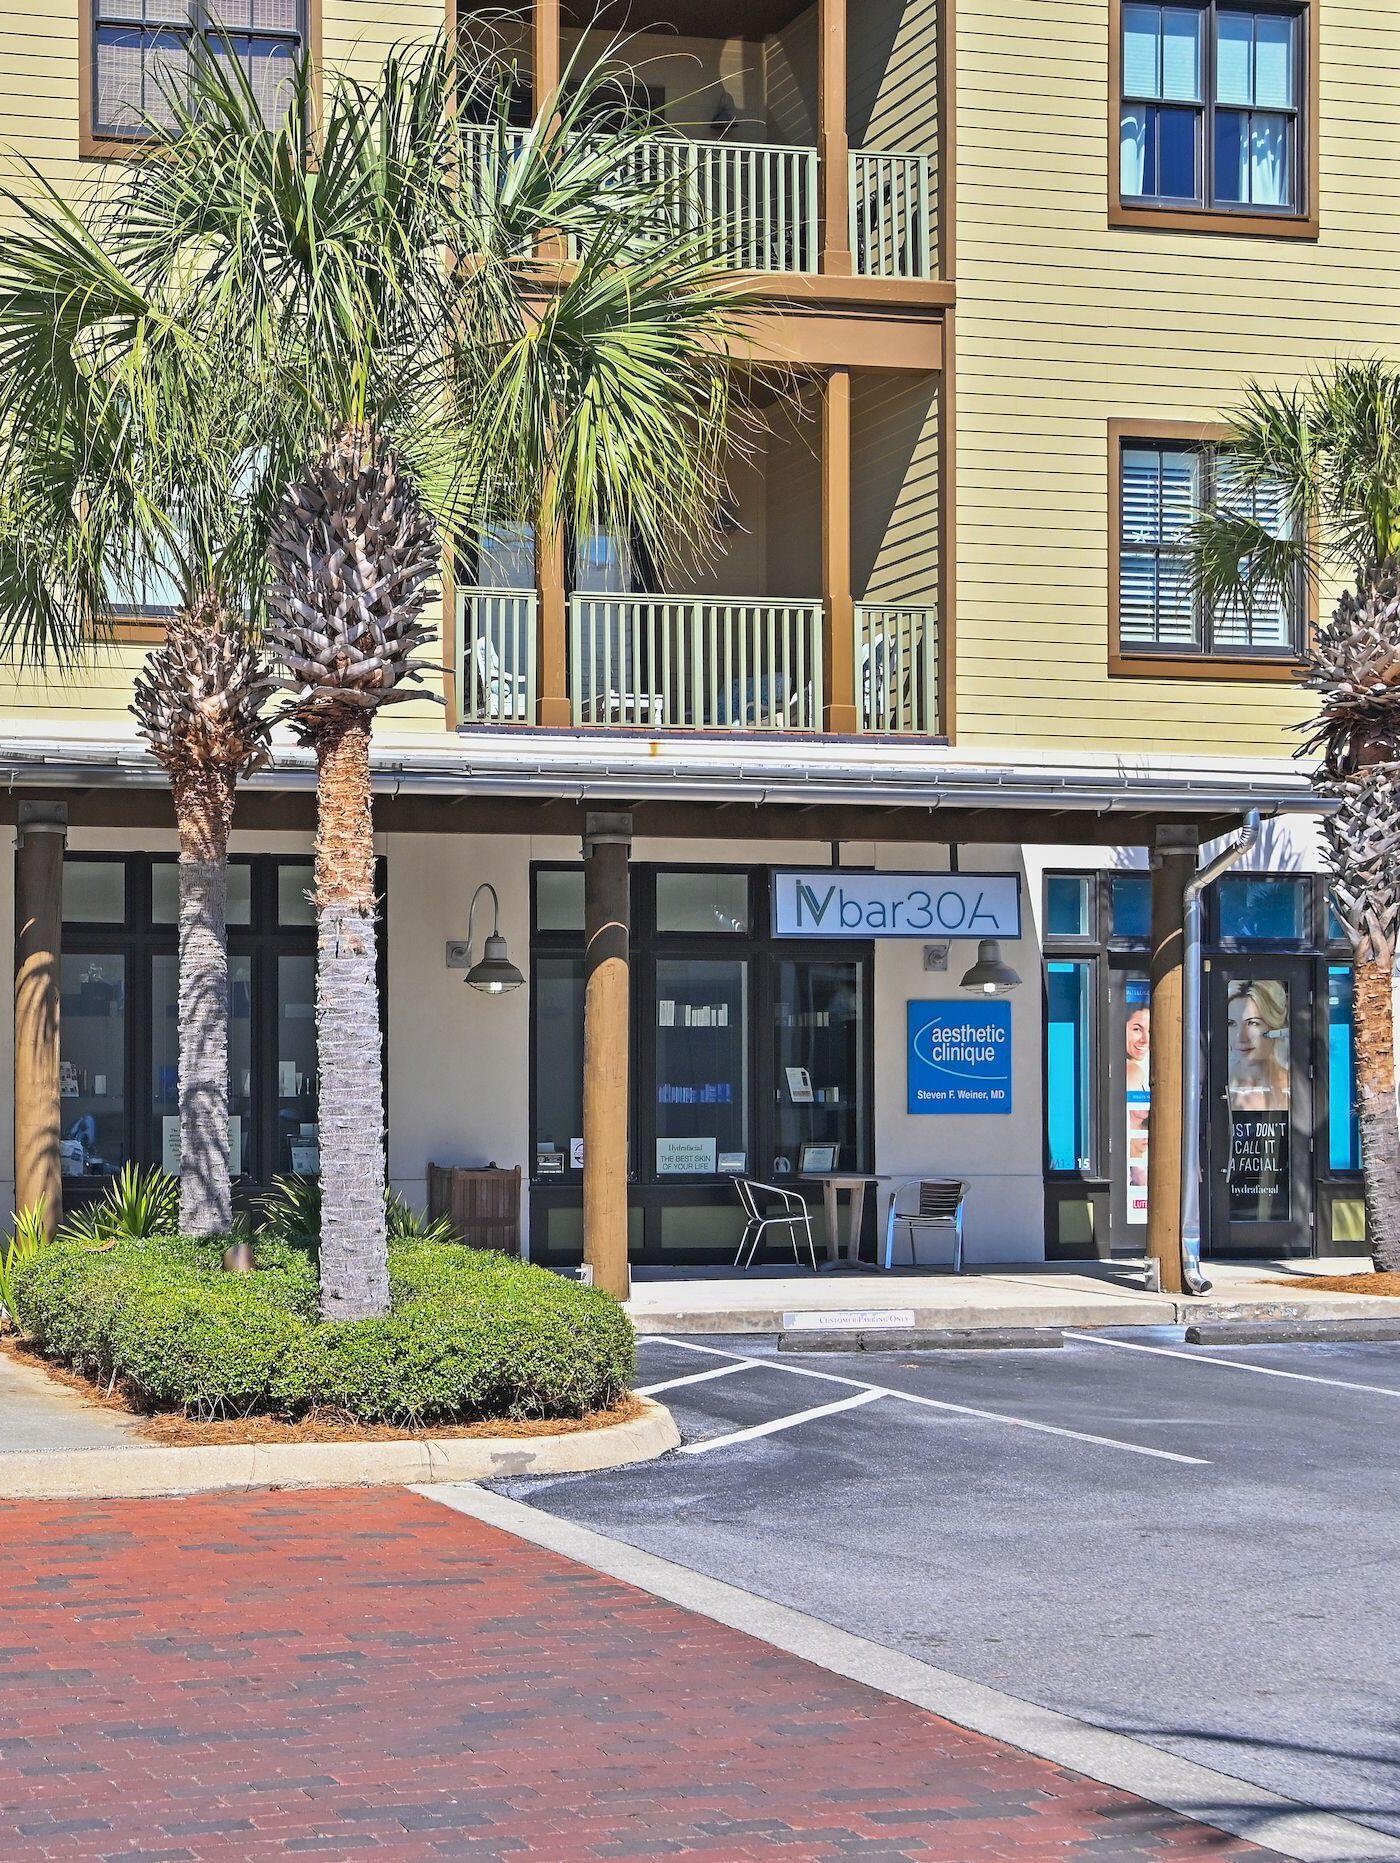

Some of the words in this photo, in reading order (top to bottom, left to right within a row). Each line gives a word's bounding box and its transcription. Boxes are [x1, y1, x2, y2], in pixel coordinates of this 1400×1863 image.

[931, 1024, 1005, 1043] aesthetic
[932, 1042, 995, 1066] clinique
[917, 1089, 947, 1100] Steven
[949, 1089, 955, 1099] F.
[957, 1089, 989, 1101] Weiner,
[990, 1089, 1005, 1099] MD
[1255, 1122, 1287, 1137] DON'T
[1234, 1140, 1260, 1154] CALL
[1264, 1140, 1275, 1154] IT
[675, 1155, 693, 1163] BEST
[1239, 1157, 1282, 1172] FACIAL.
